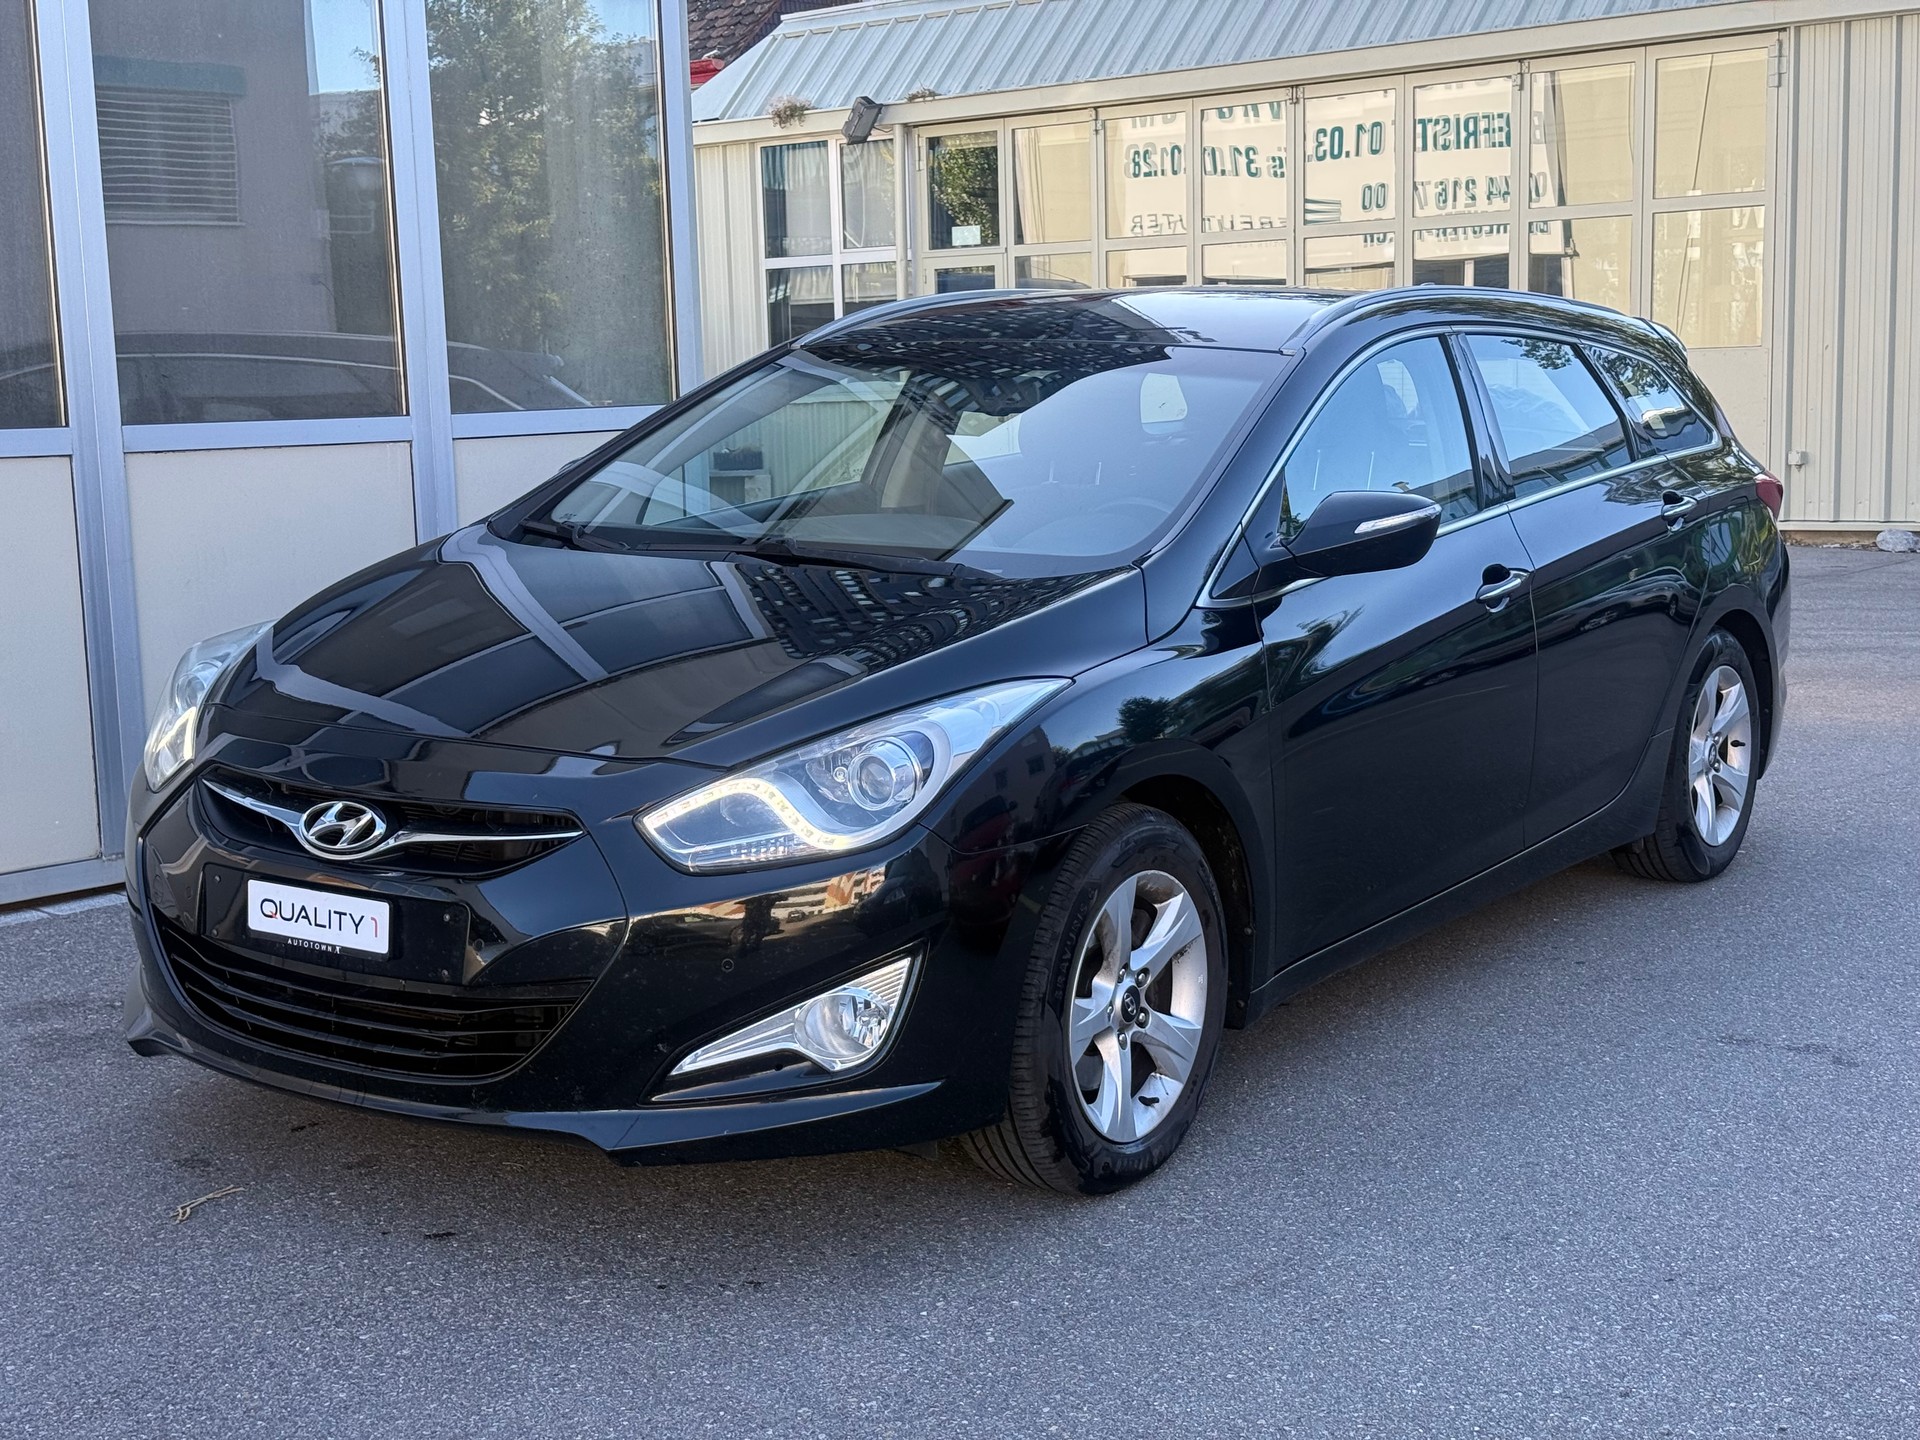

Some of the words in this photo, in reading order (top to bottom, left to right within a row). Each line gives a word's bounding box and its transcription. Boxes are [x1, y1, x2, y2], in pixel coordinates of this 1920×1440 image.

[260, 898, 365, 935] QUALITY
[370, 916, 378, 938] 1
[287, 937, 332, 952] AUTOTOWN
